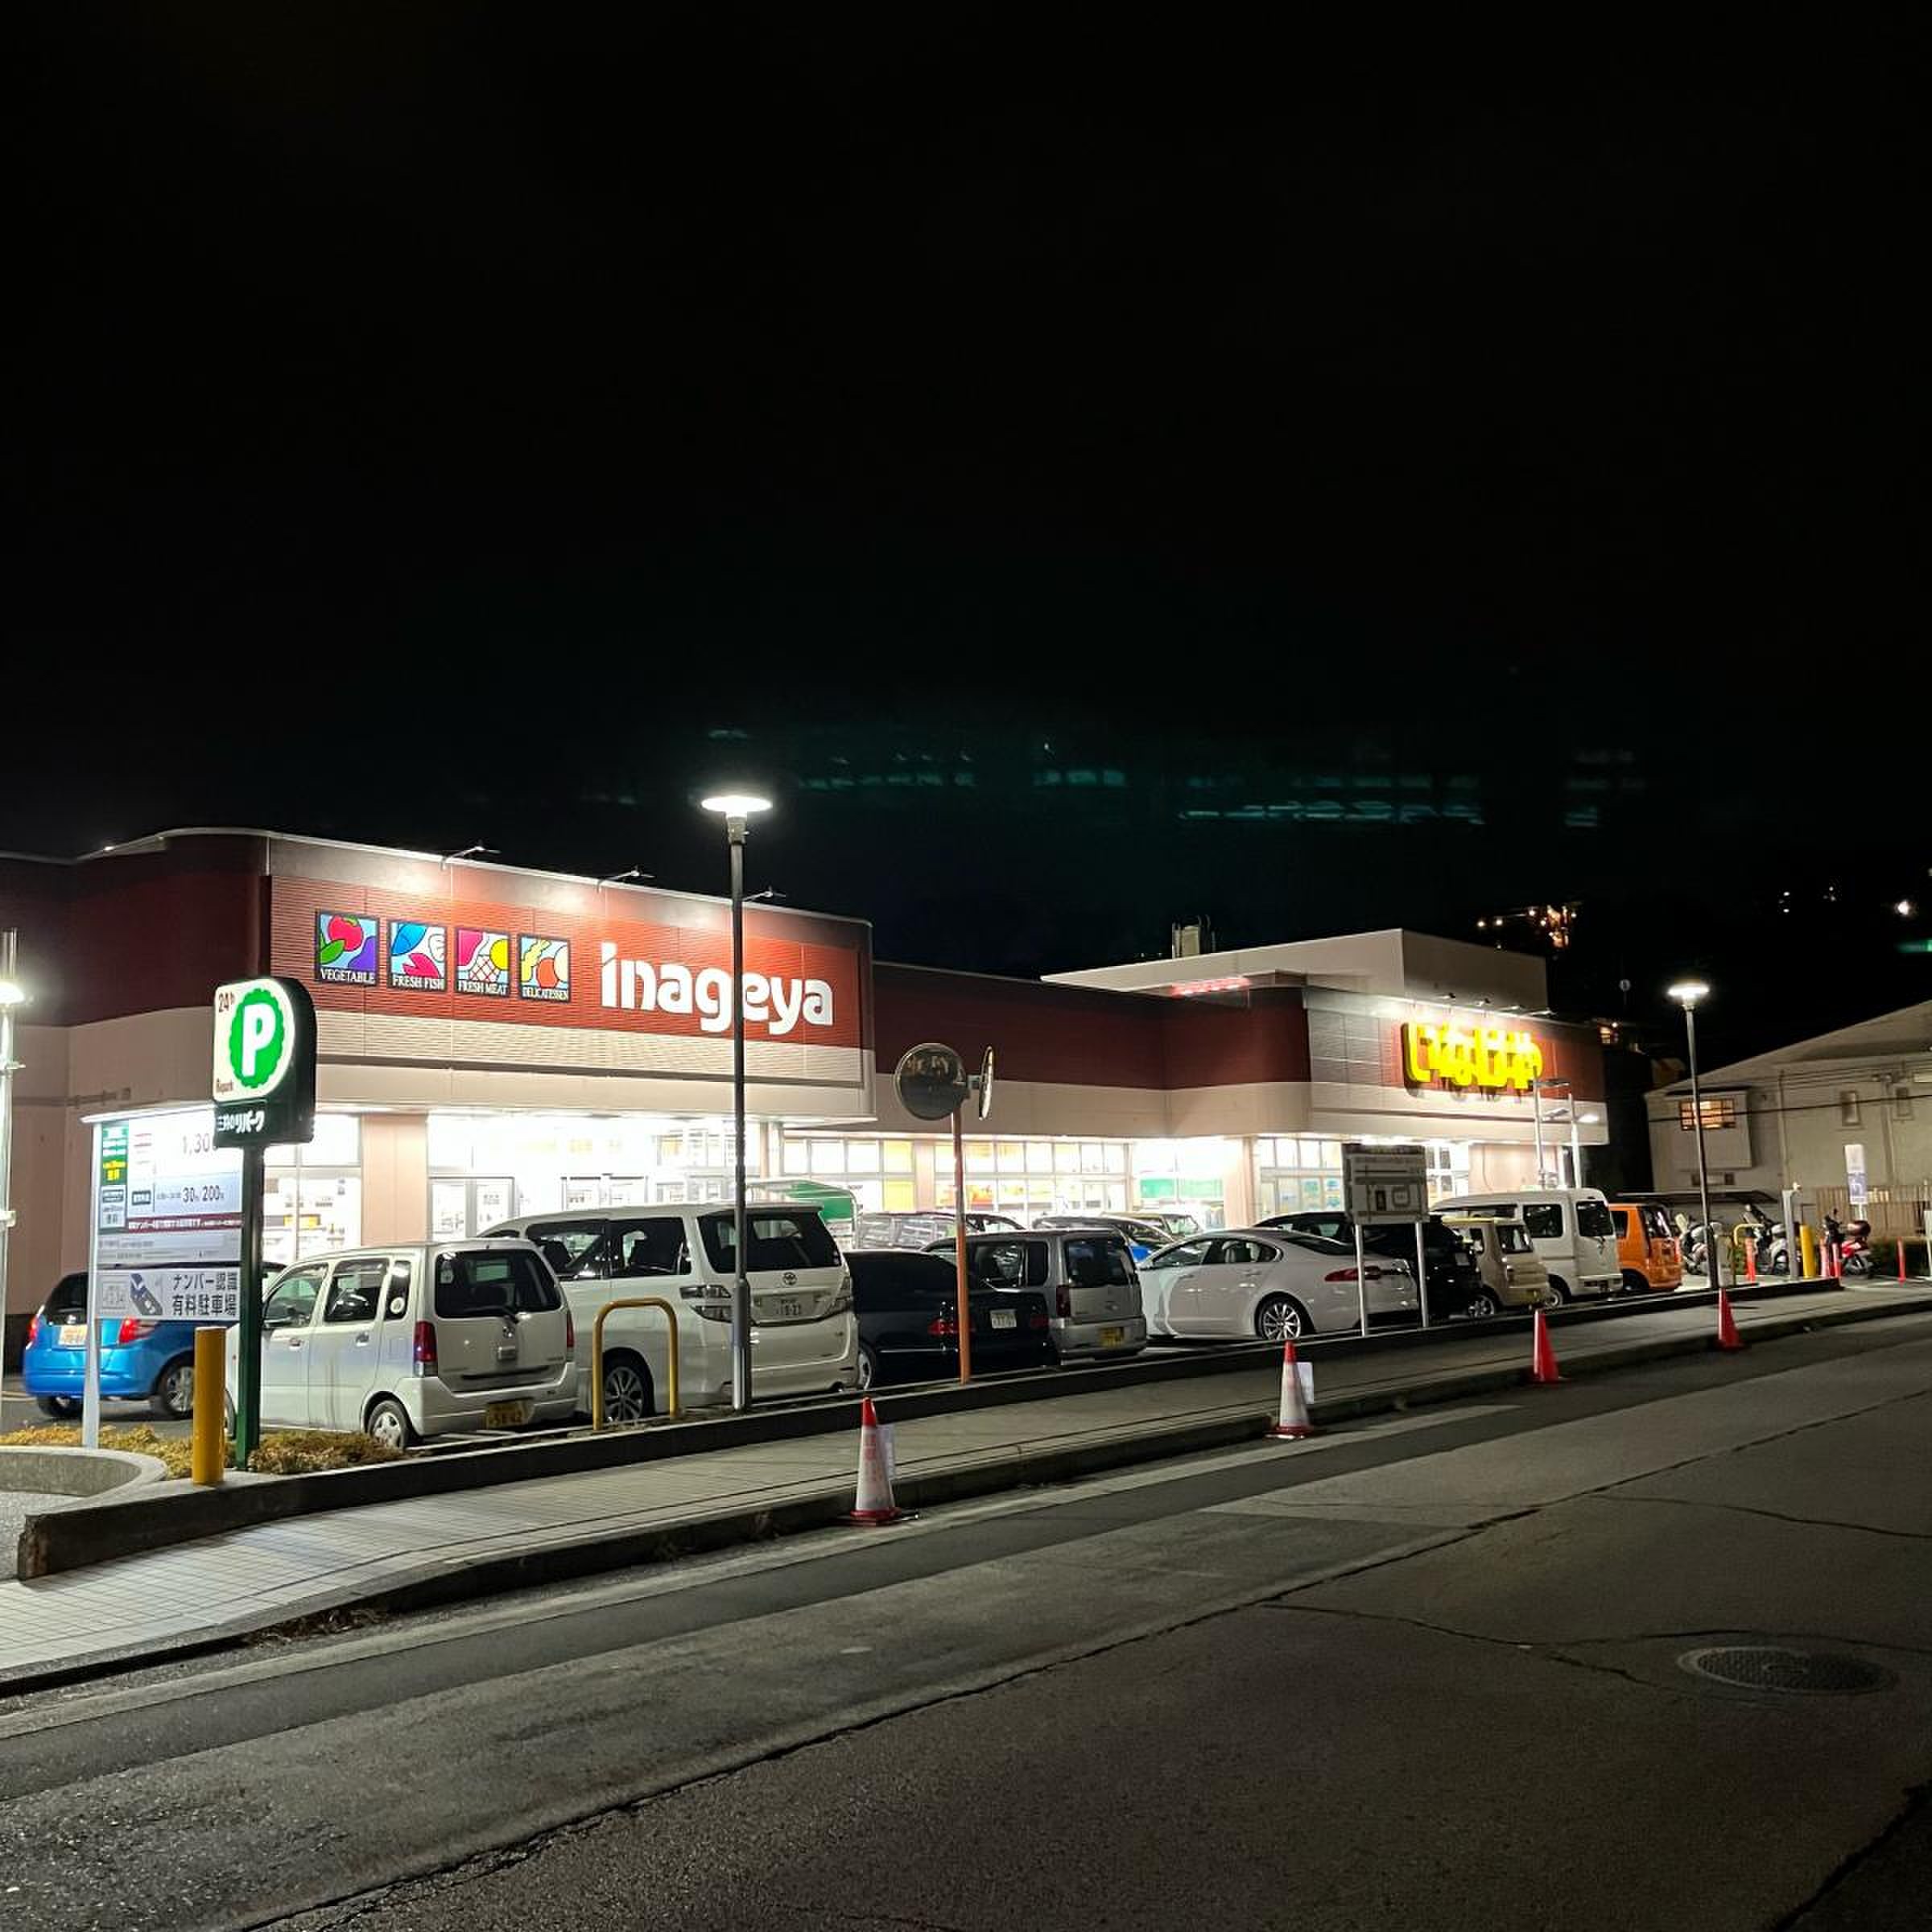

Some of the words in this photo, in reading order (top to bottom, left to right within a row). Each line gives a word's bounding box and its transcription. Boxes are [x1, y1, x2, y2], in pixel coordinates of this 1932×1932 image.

[320, 968, 376, 985] VEGETABLE
[392, 973, 422, 988] FRESH
[424, 977, 444, 990] FISH
[601, 941, 834, 1035] inageya
[457, 981, 483, 993] FRESH
[485, 984, 508, 996] MEAT
[242, 1003, 277, 1078] P
[1407, 1020, 1543, 1090] いなげや
[171, 1294, 237, 1317] 有料駐車場
